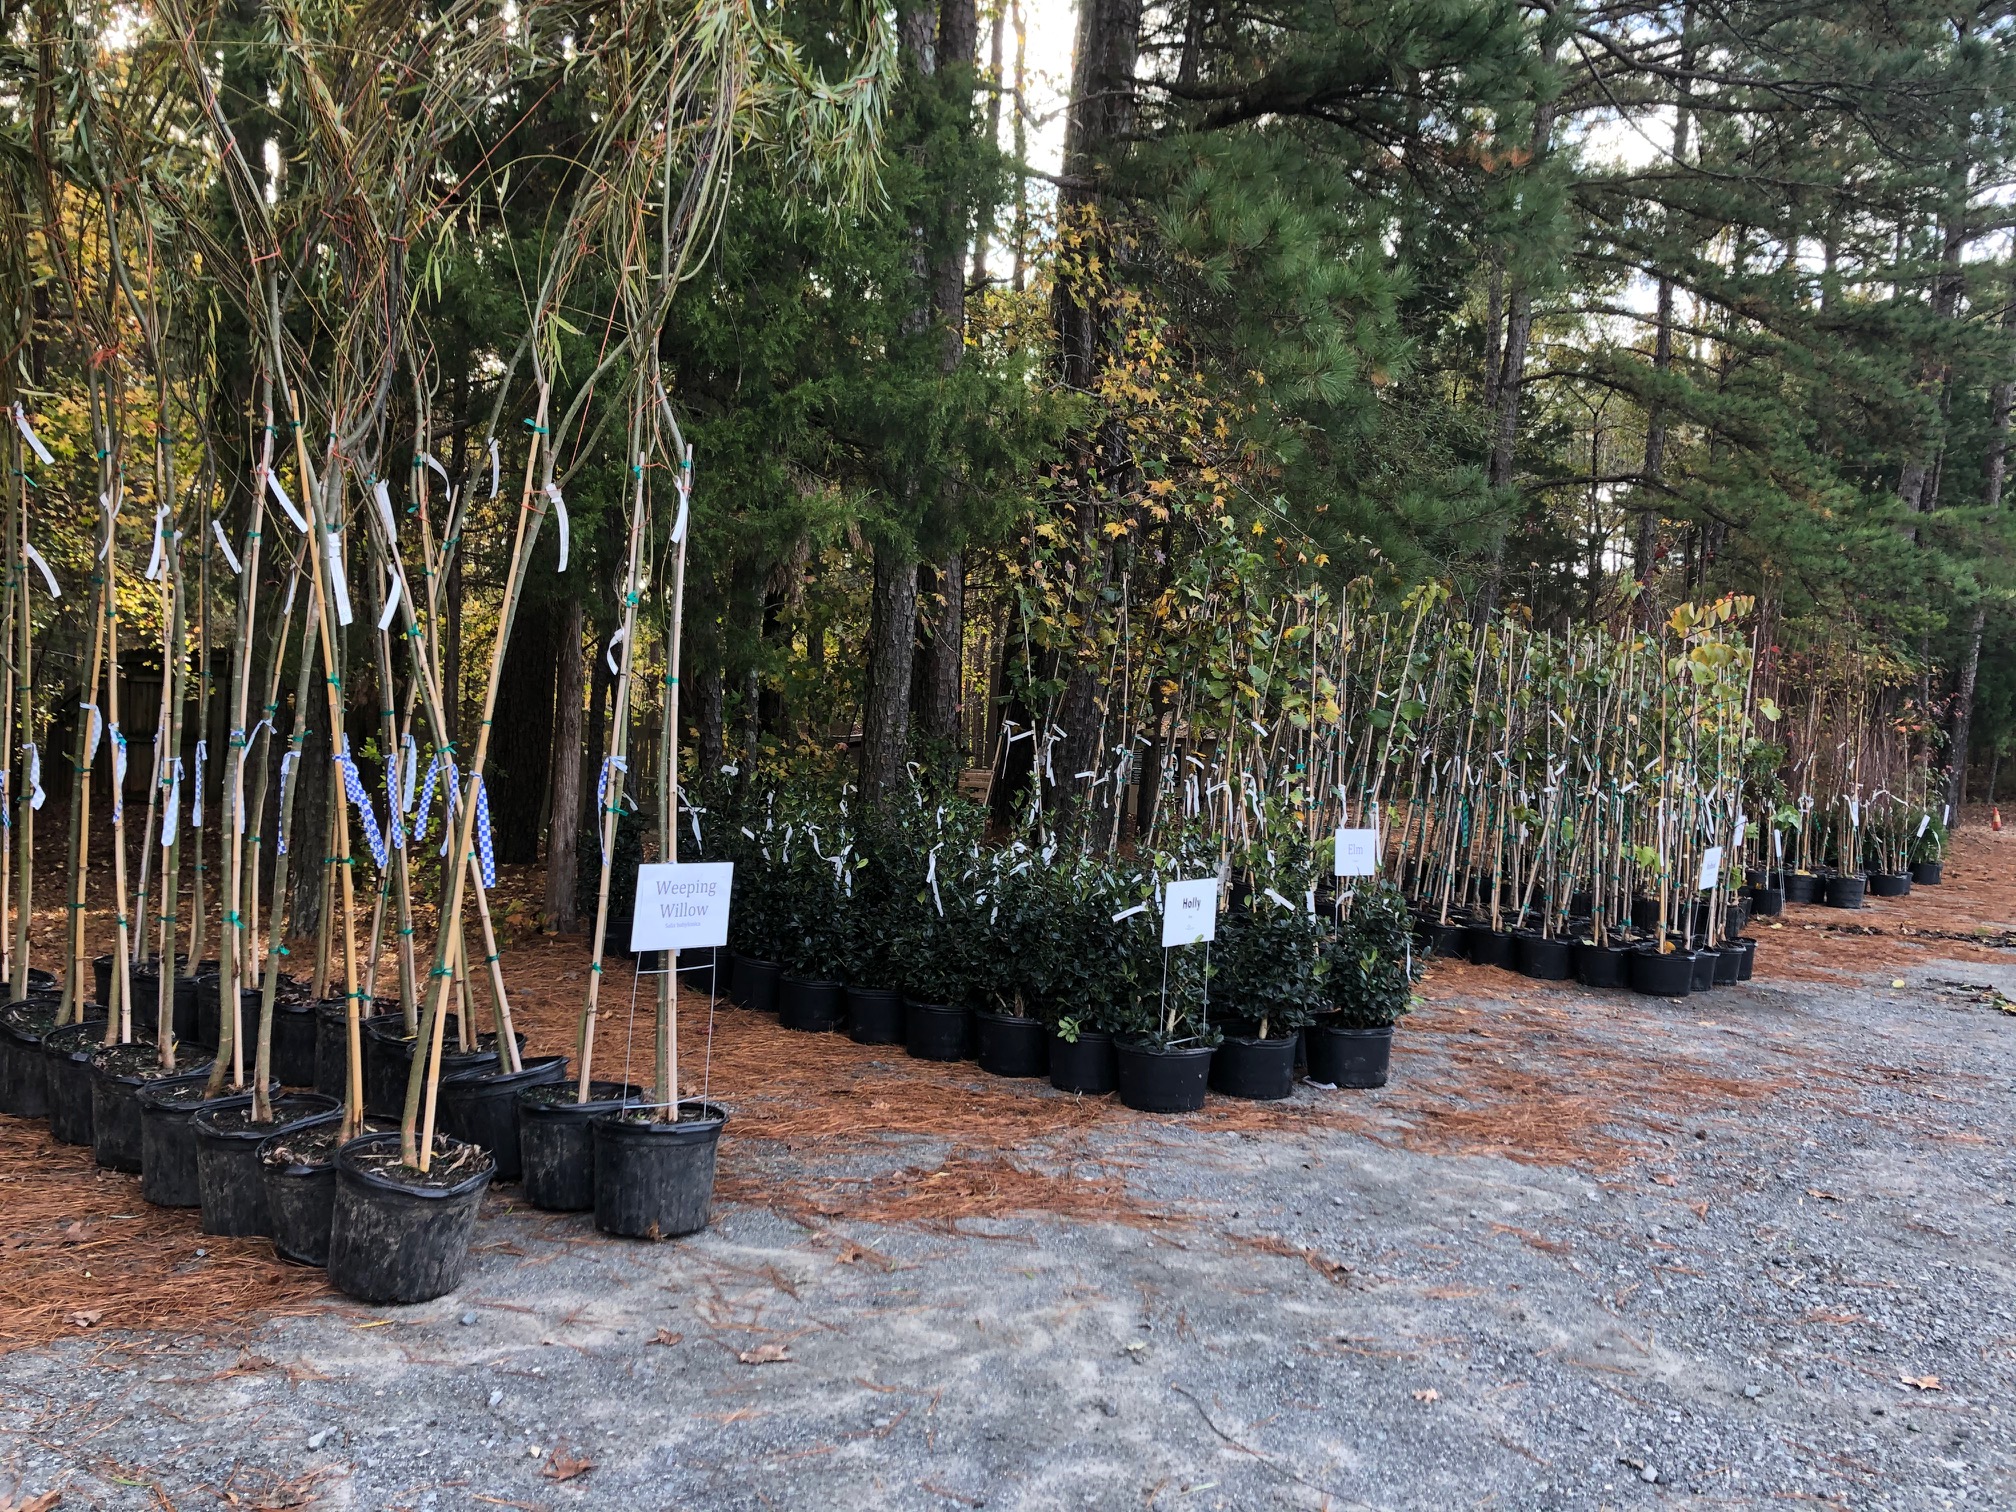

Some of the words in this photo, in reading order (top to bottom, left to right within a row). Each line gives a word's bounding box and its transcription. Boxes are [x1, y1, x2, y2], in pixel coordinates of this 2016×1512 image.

[1348, 843, 1364, 855] Elm
[656, 880, 717, 898] Weeping
[660, 902, 709, 918] Willow
[1182, 896, 1202, 911] Holly
